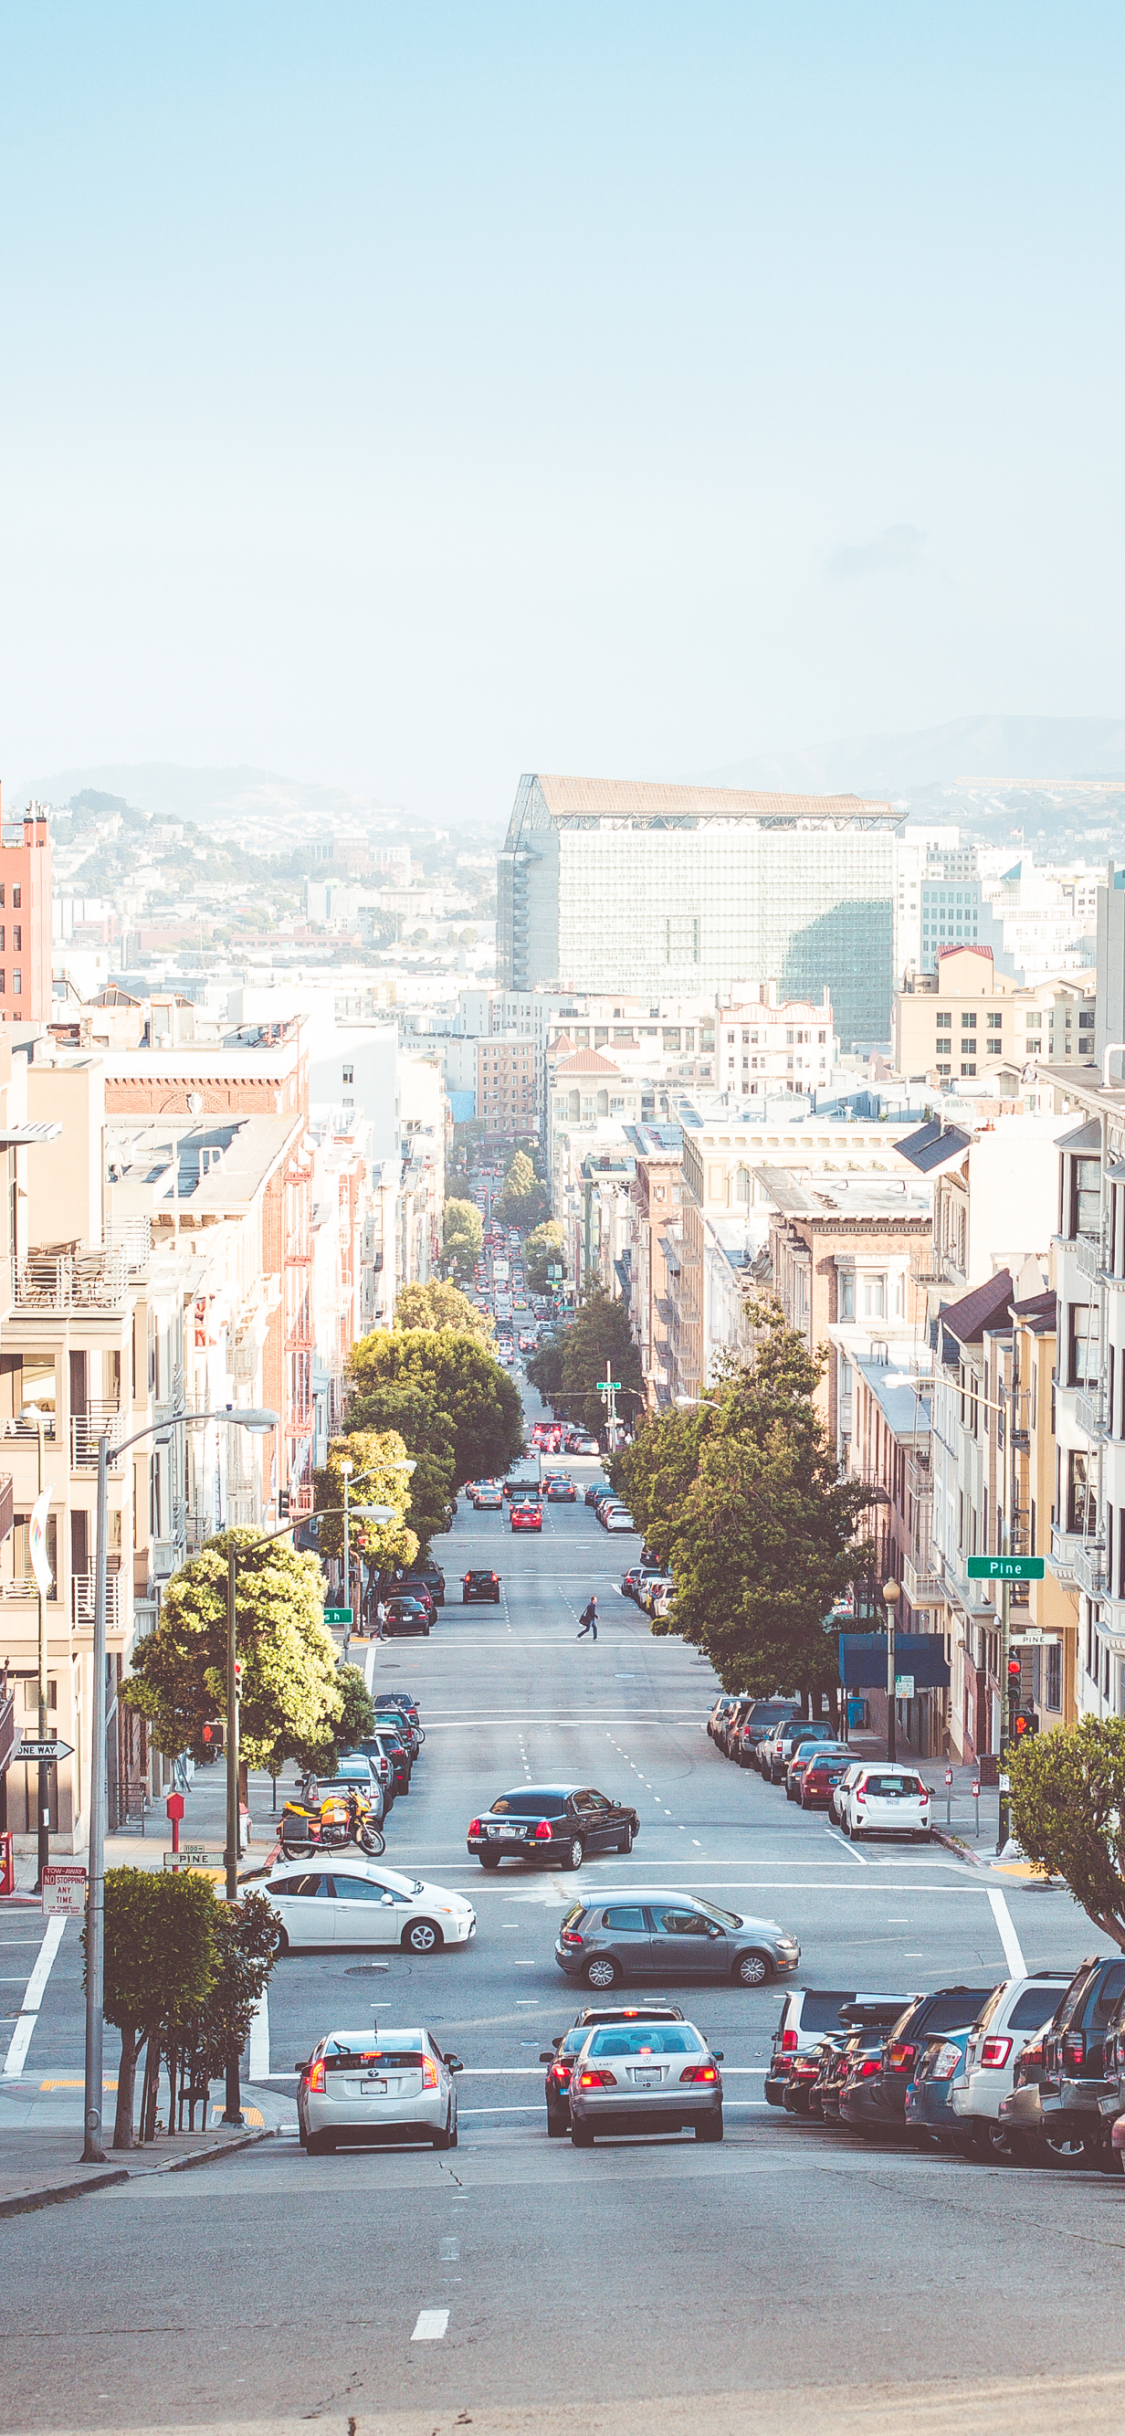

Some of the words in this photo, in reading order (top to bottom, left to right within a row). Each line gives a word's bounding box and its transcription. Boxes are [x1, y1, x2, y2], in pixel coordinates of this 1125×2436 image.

[990, 1562, 1022, 1574] Pine
[37, 1746, 56, 1755] WAY
[179, 1855, 208, 1863] PINE
[47, 1867, 83, 1875] TOW-AWAY
[44, 1874, 55, 1885] NO
[56, 1876, 85, 1885] STOPPING
[57, 1886, 72, 1894] ANY
[56, 1896, 73, 1904] TIME
